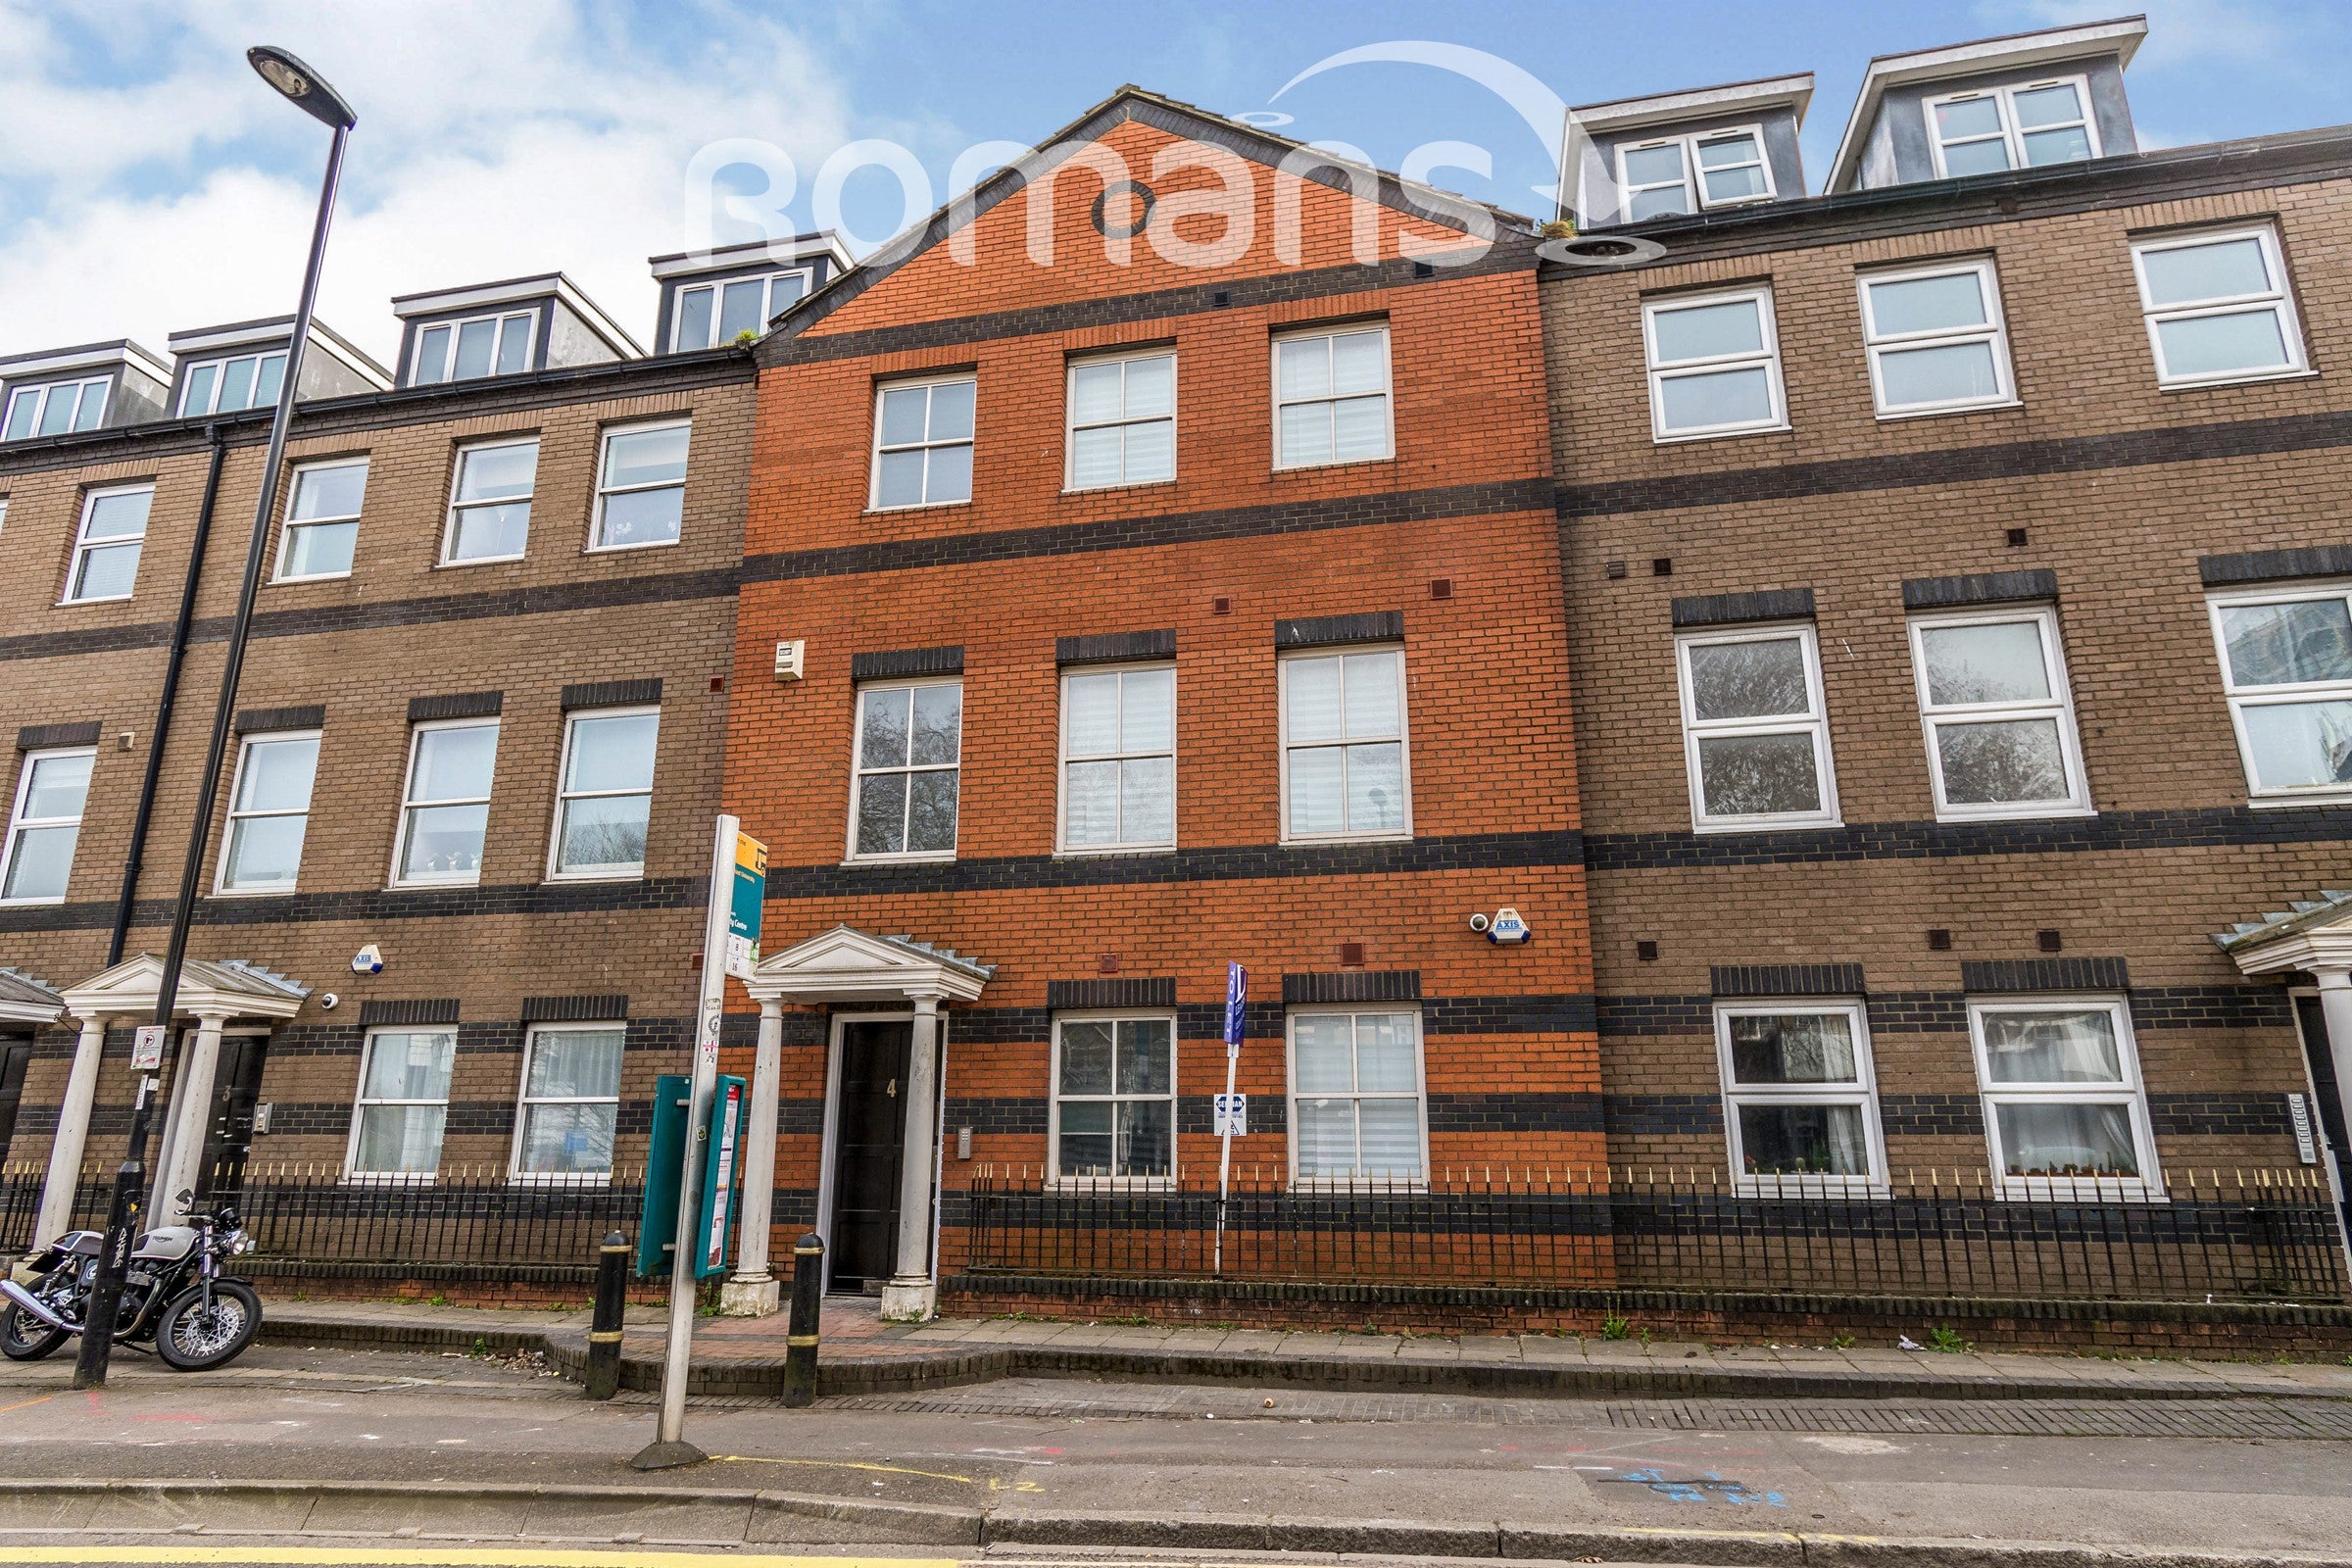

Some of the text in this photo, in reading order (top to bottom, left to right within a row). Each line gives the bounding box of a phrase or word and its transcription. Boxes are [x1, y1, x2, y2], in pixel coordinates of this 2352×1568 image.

[1228, 968, 1236, 995] TO
[222, 1085, 231, 1102] 3
[886, 1078, 897, 1098] 4
